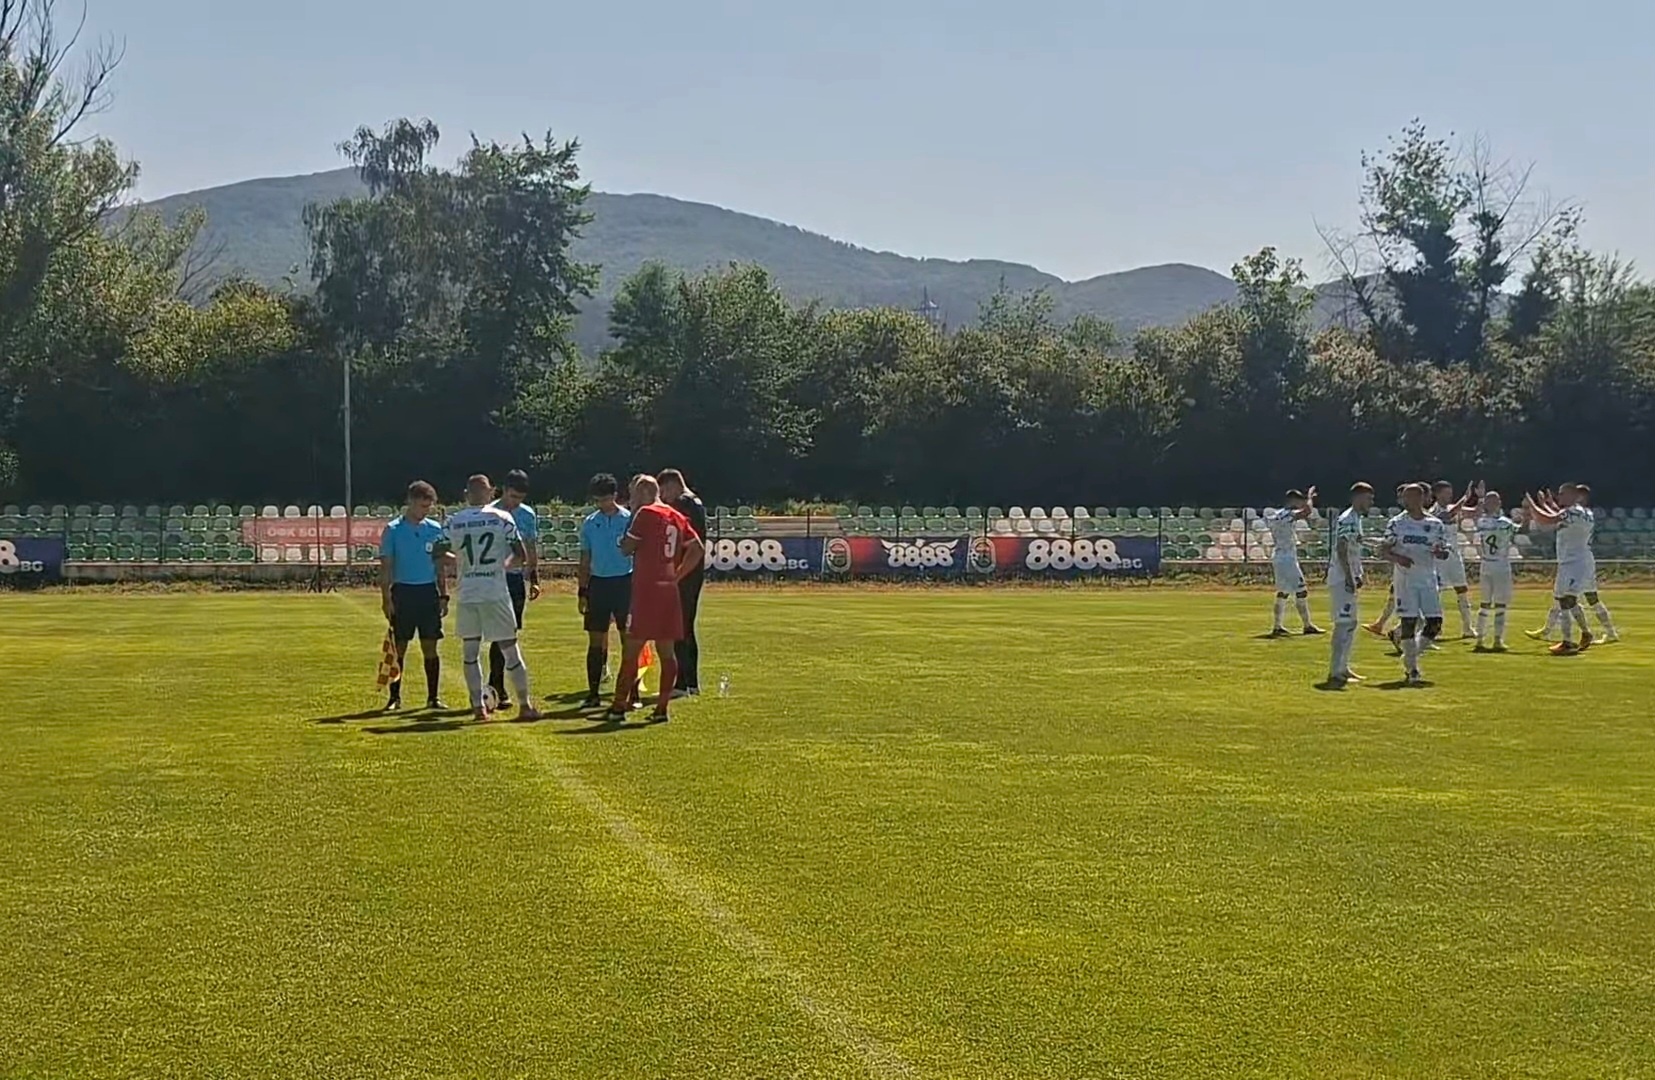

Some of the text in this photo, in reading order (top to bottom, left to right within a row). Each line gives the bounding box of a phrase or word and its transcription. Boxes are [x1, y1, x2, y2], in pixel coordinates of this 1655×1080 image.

[460, 531, 497, 567] 12
[664, 524, 678, 558] 3
[1485, 534, 1498, 555] 8
[888, 545, 954, 567] 8888
